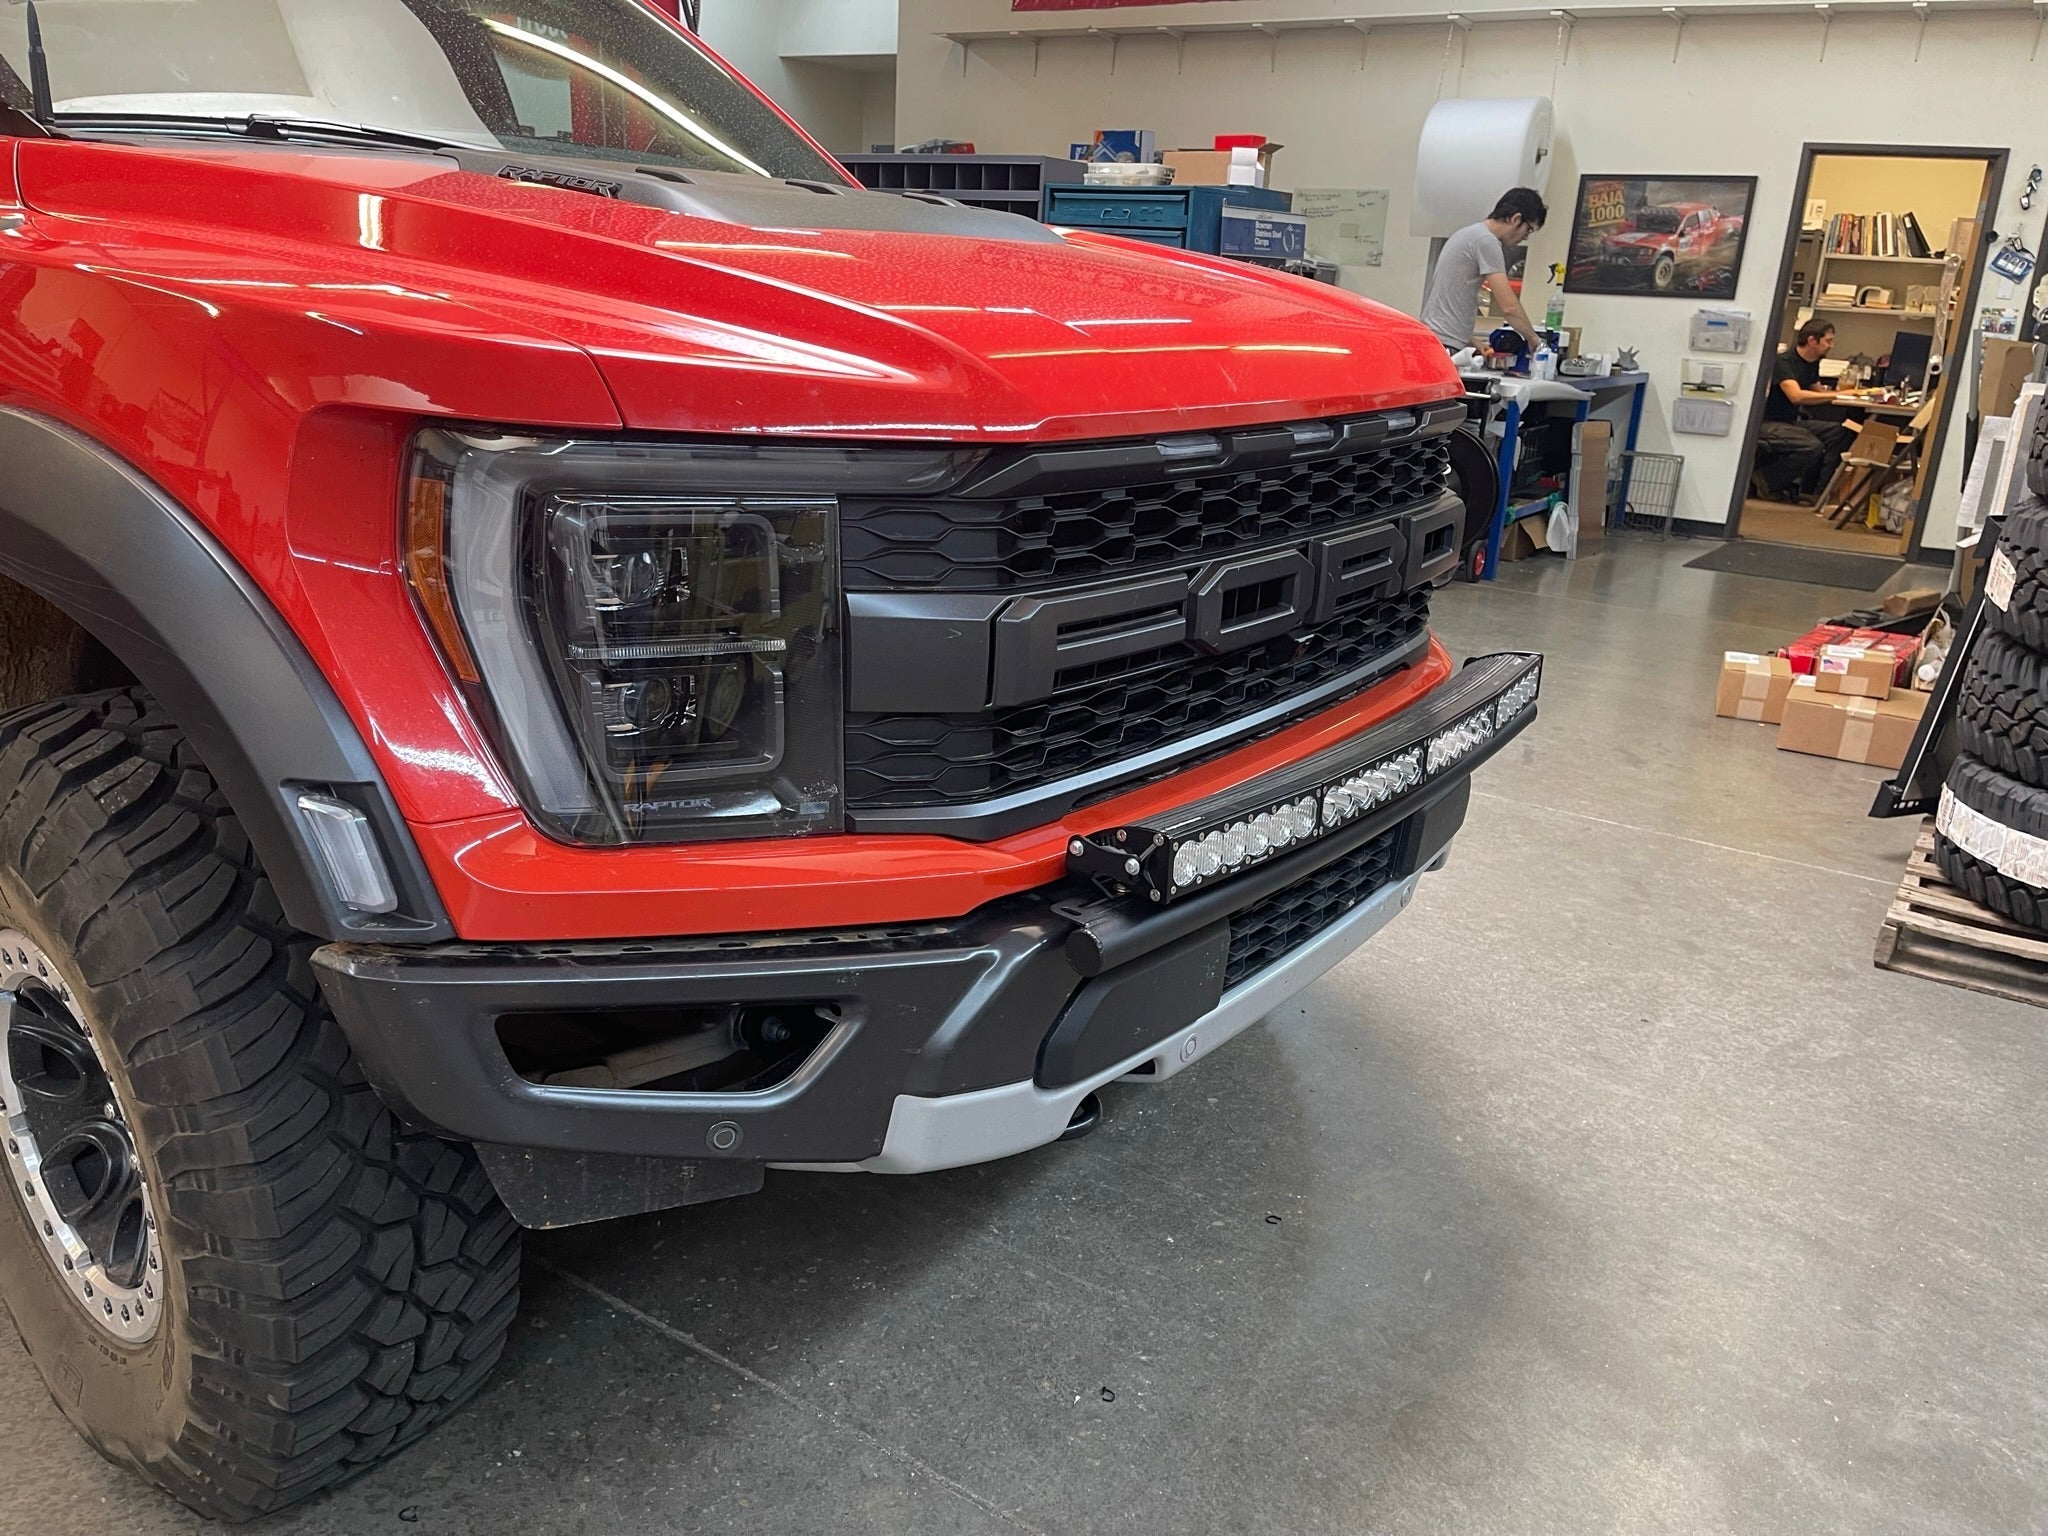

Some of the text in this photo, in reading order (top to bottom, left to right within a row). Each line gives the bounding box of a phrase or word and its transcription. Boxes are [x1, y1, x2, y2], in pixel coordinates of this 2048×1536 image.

[497, 164, 618, 199] RAPTOR
[1588, 190, 1625, 208] BAJA
[1590, 204, 1625, 222] 1000
[996, 492, 1466, 707] FORD
[623, 797, 715, 813] RAPTOR
